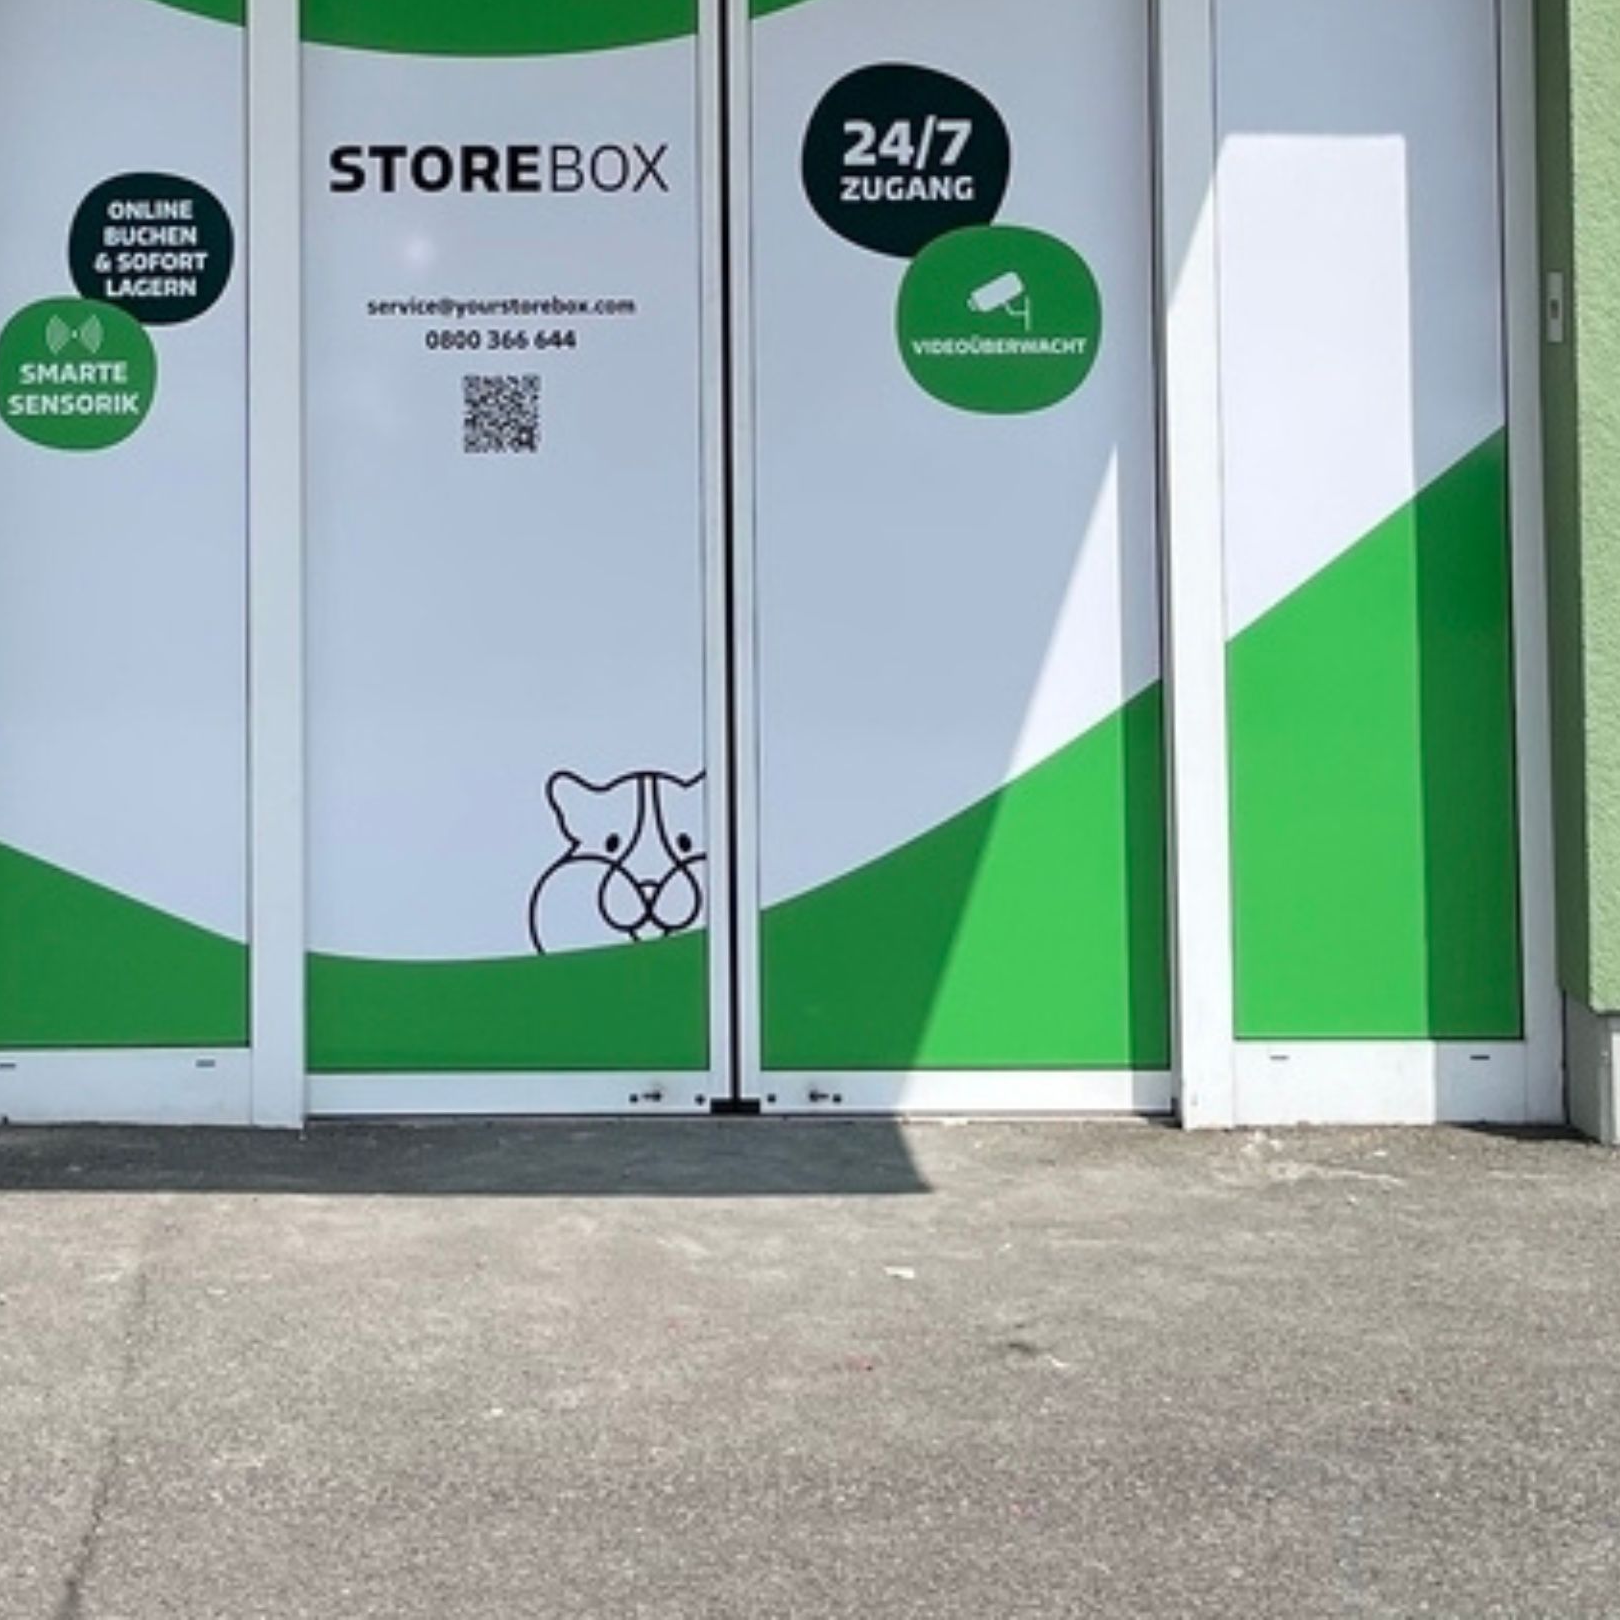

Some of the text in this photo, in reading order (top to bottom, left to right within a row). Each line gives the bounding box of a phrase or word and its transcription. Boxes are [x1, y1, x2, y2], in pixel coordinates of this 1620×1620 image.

[842, 115, 973, 170] 24/7
[329, 143, 669, 193] STOREBOX
[839, 176, 975, 202] ZUGANG
[107, 200, 193, 220] ONLINE
[103, 226, 197, 247] BUCHEN
[94, 253, 208, 273] & SOFORT
[105, 278, 197, 298] LAGERN
[367, 295, 636, 318] service@yourstorebox.com
[425, 329, 577, 350] 0800 366 644
[911, 333, 1087, 356] VIDEOÜBERWACHT
[19, 362, 128, 386] SMARTE
[7, 393, 140, 416] SENSORIK
